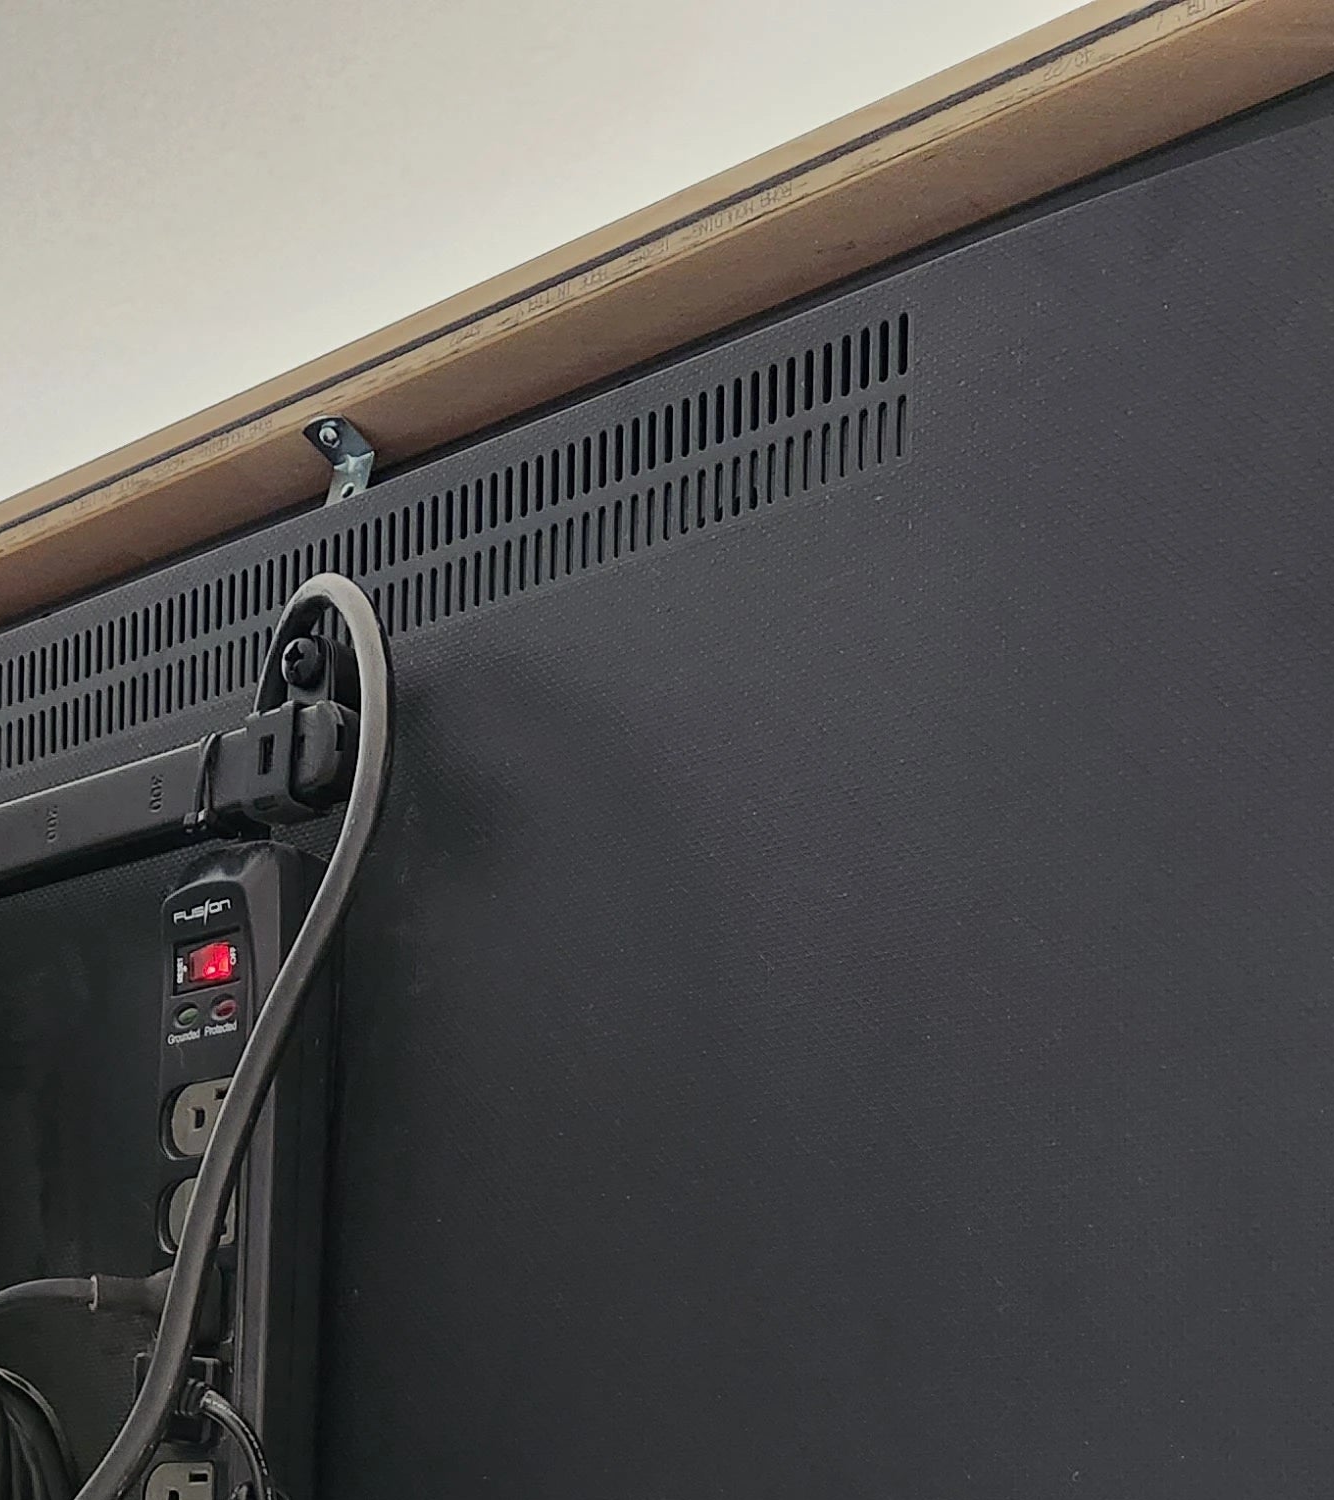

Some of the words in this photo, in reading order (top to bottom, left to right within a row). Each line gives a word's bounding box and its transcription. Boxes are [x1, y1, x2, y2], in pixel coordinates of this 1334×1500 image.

[176, 957, 184, 985] RESET
[167, 1027, 201, 1045] Grounded
[203, 1019, 238, 1038] Protected
